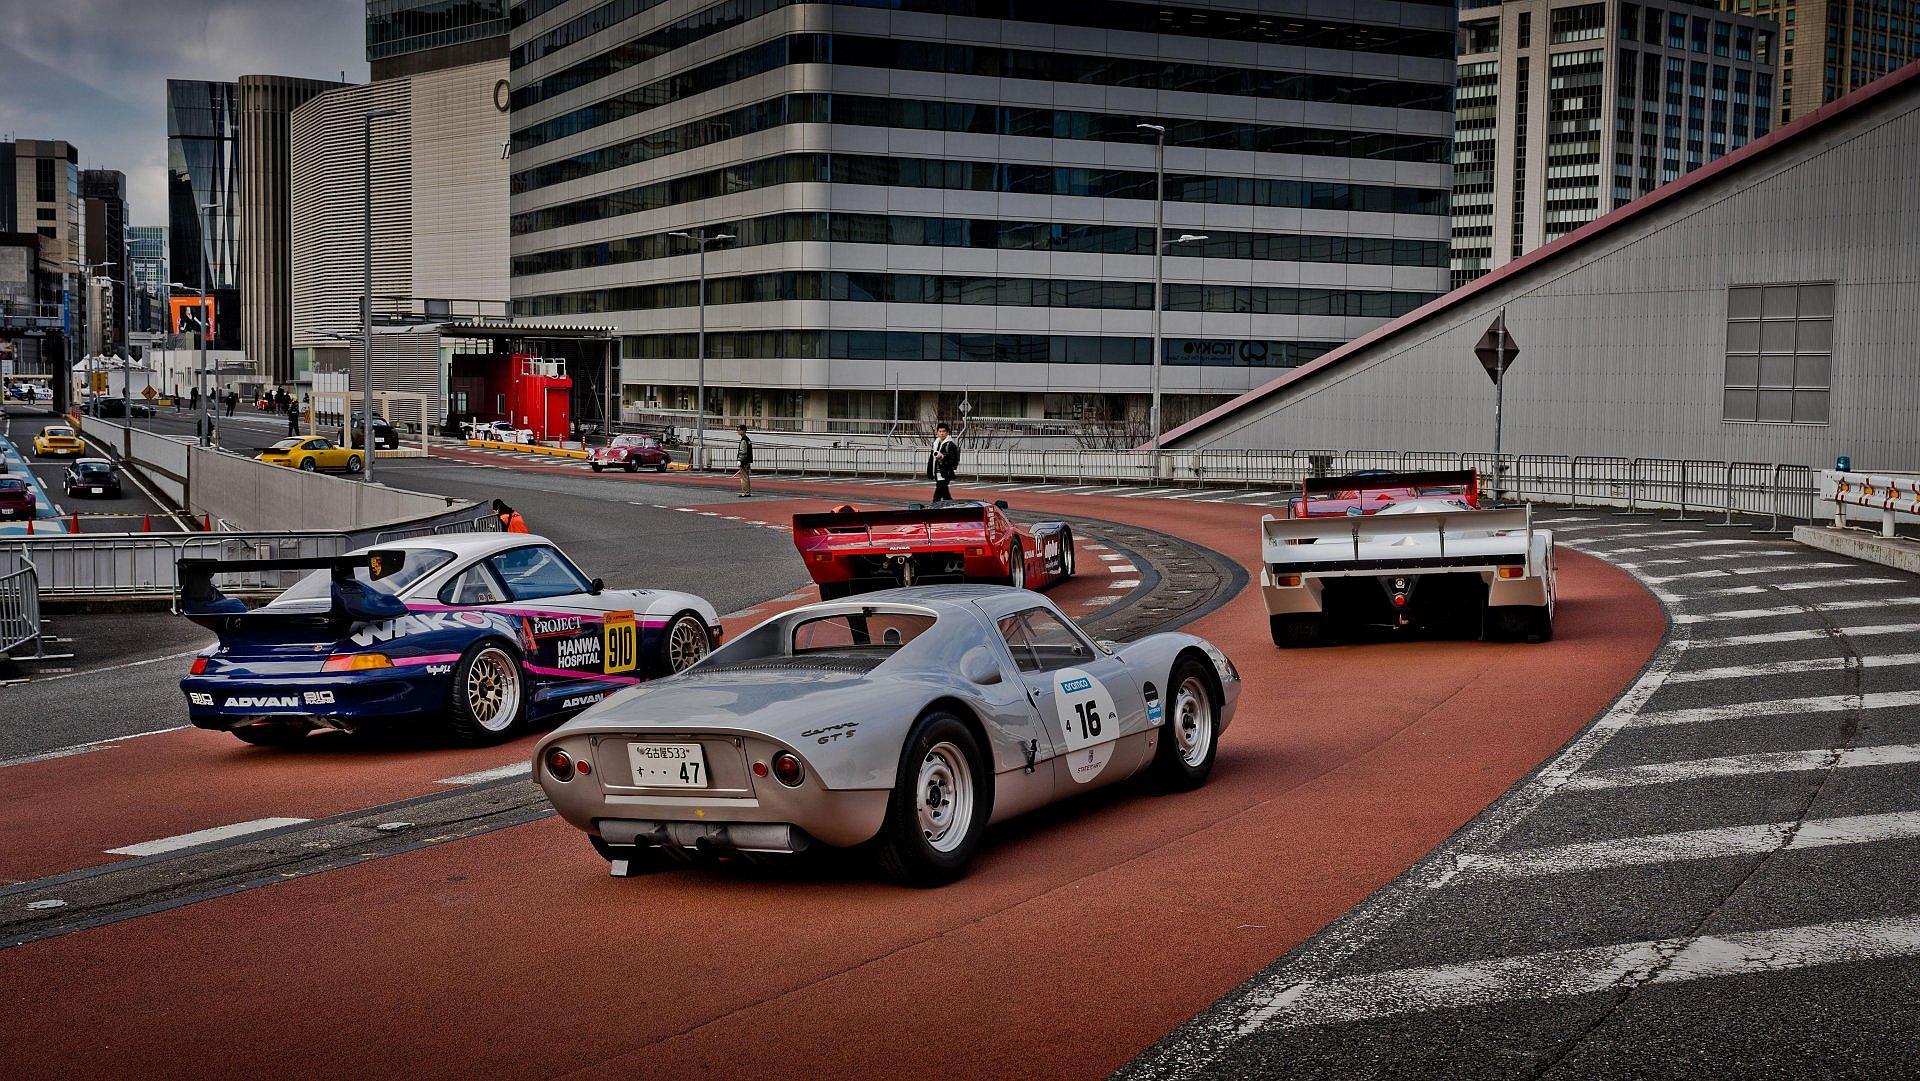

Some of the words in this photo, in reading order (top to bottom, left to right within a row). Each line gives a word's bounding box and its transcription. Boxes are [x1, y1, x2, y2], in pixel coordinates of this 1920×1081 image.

[534, 616, 582, 634] PROJECT
[557, 637, 600, 656] HANWA
[609, 626, 632, 668] 910
[557, 652, 600, 669] HOSPITAL
[224, 697, 300, 707] ADVAN
[562, 694, 604, 708] ADVAN
[1066, 719, 1072, 733] 4
[1074, 700, 1102, 739] 16
[801, 721, 859, 737] Carrera
[818, 730, 856, 745] GTS
[680, 762, 699, 783] 47
